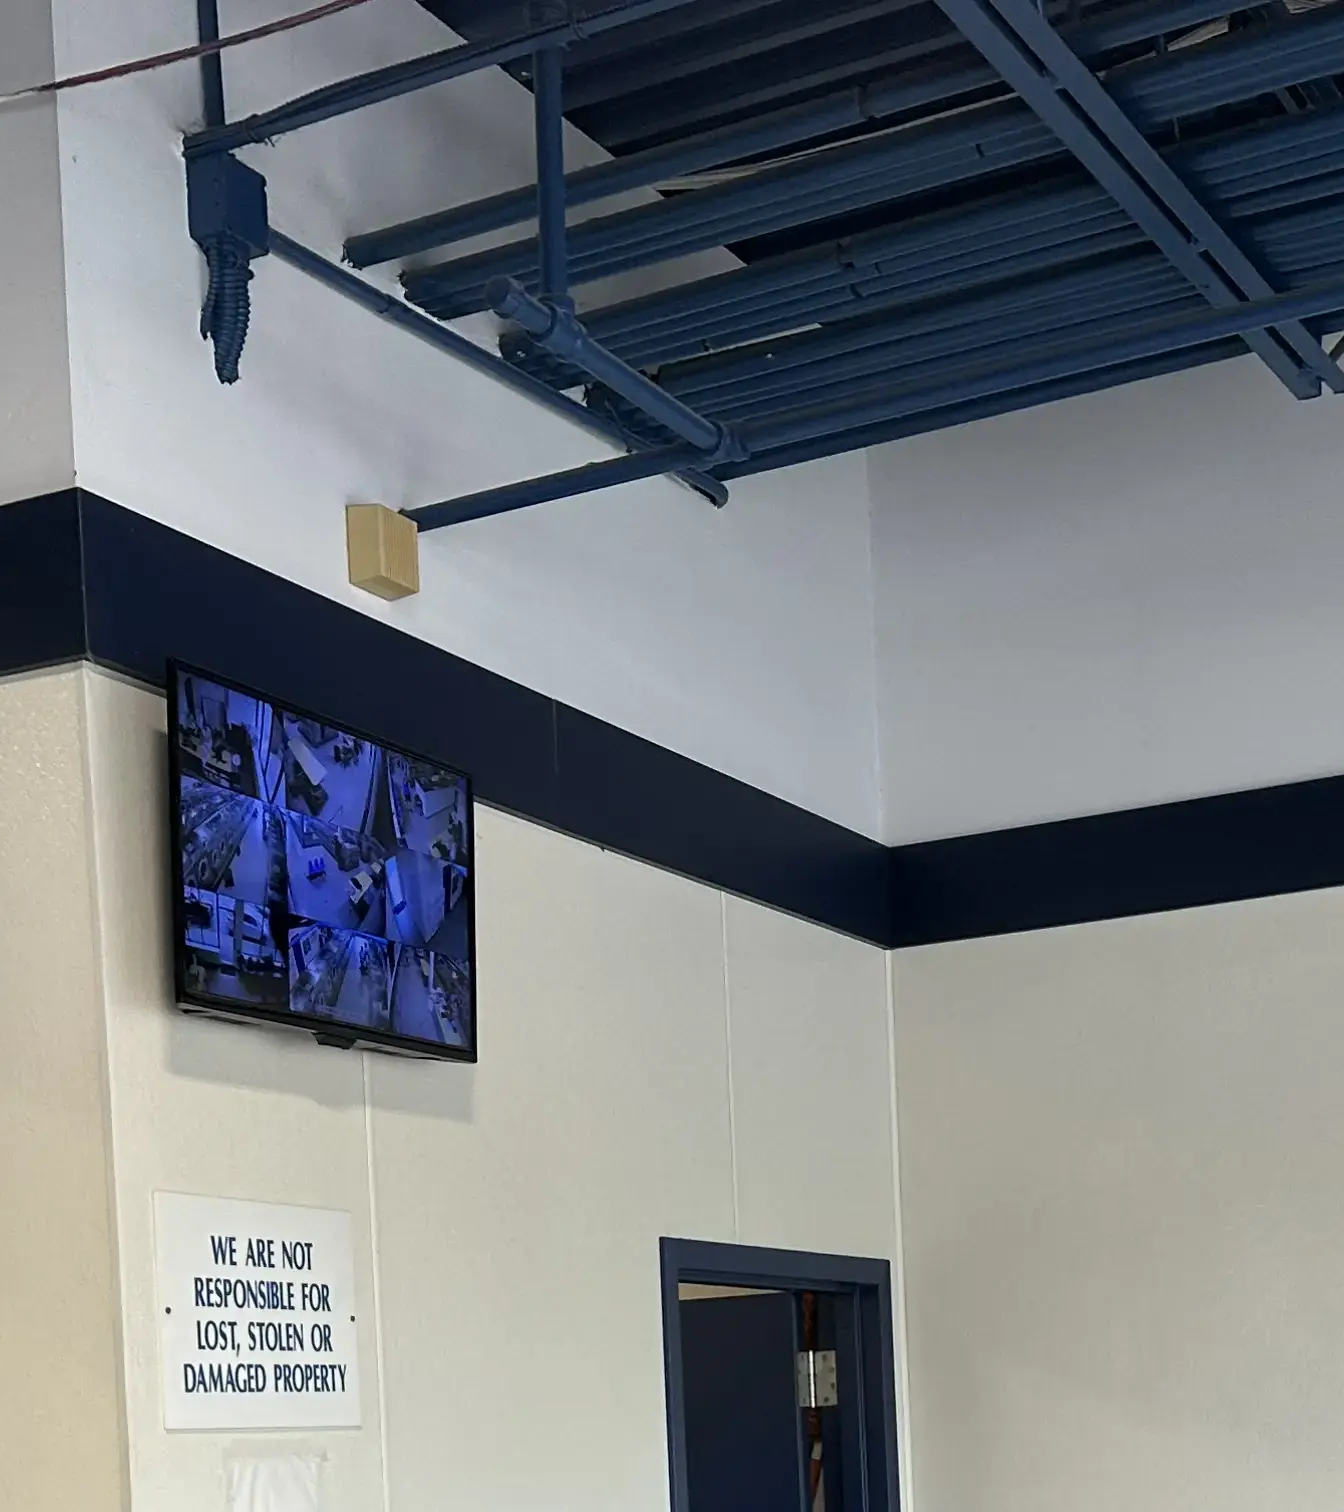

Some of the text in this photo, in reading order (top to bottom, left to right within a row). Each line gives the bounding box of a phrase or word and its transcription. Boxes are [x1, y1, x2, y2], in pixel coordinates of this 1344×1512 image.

[210, 1235, 313, 1271] WE ARE NOT
[194, 1276, 332, 1312] RESPONSIBLE FOR
[196, 1320, 333, 1357] LOST, STOLEN OR
[183, 1363, 347, 1393] DAMAGED PROPERTY
